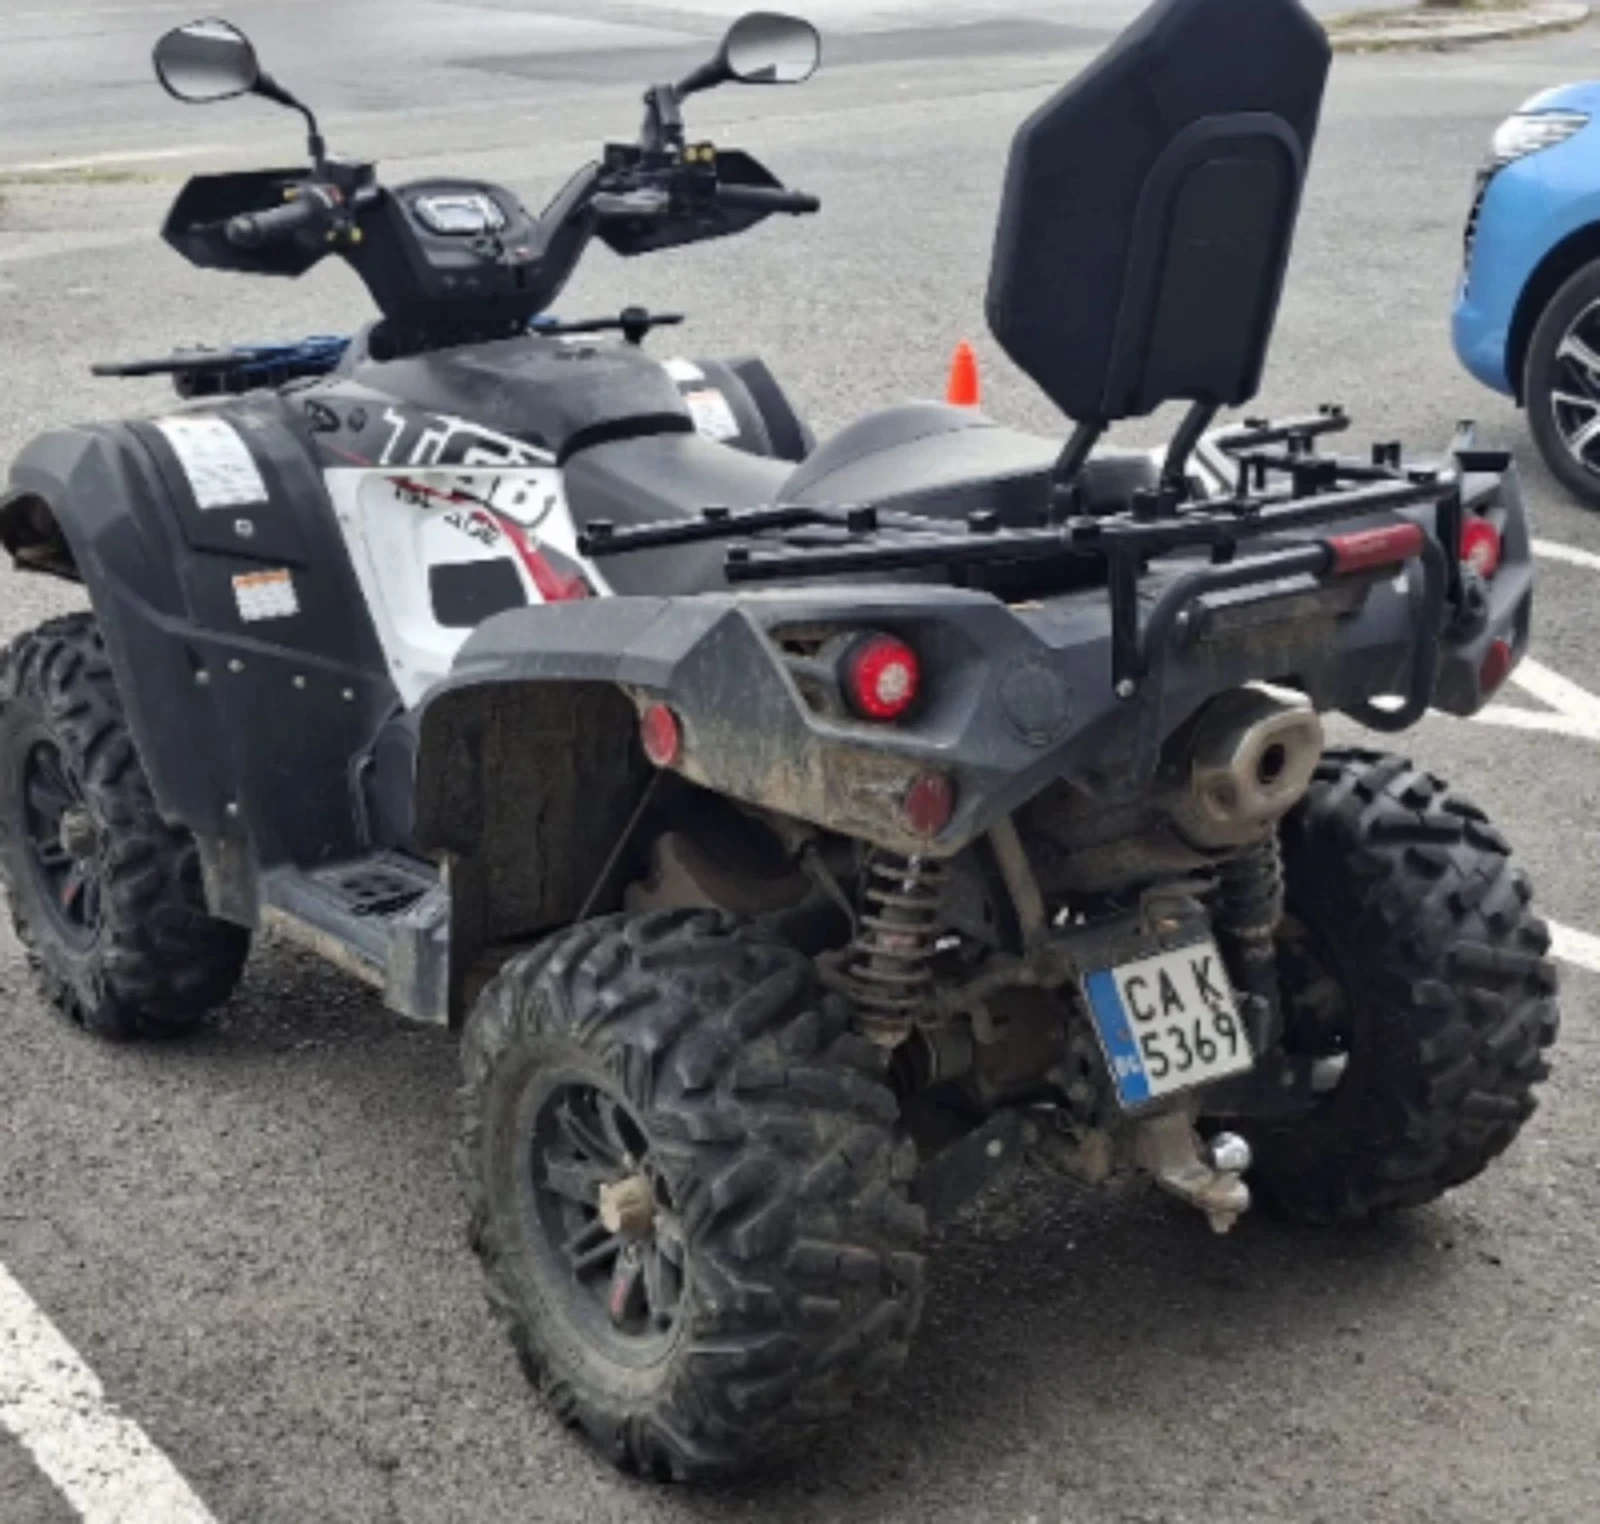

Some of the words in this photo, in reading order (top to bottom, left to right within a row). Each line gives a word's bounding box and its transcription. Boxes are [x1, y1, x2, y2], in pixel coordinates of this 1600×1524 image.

[1124, 967, 1185, 1021] CA
[1189, 955, 1224, 1004] K
[1140, 1011, 1237, 1077] 5369
